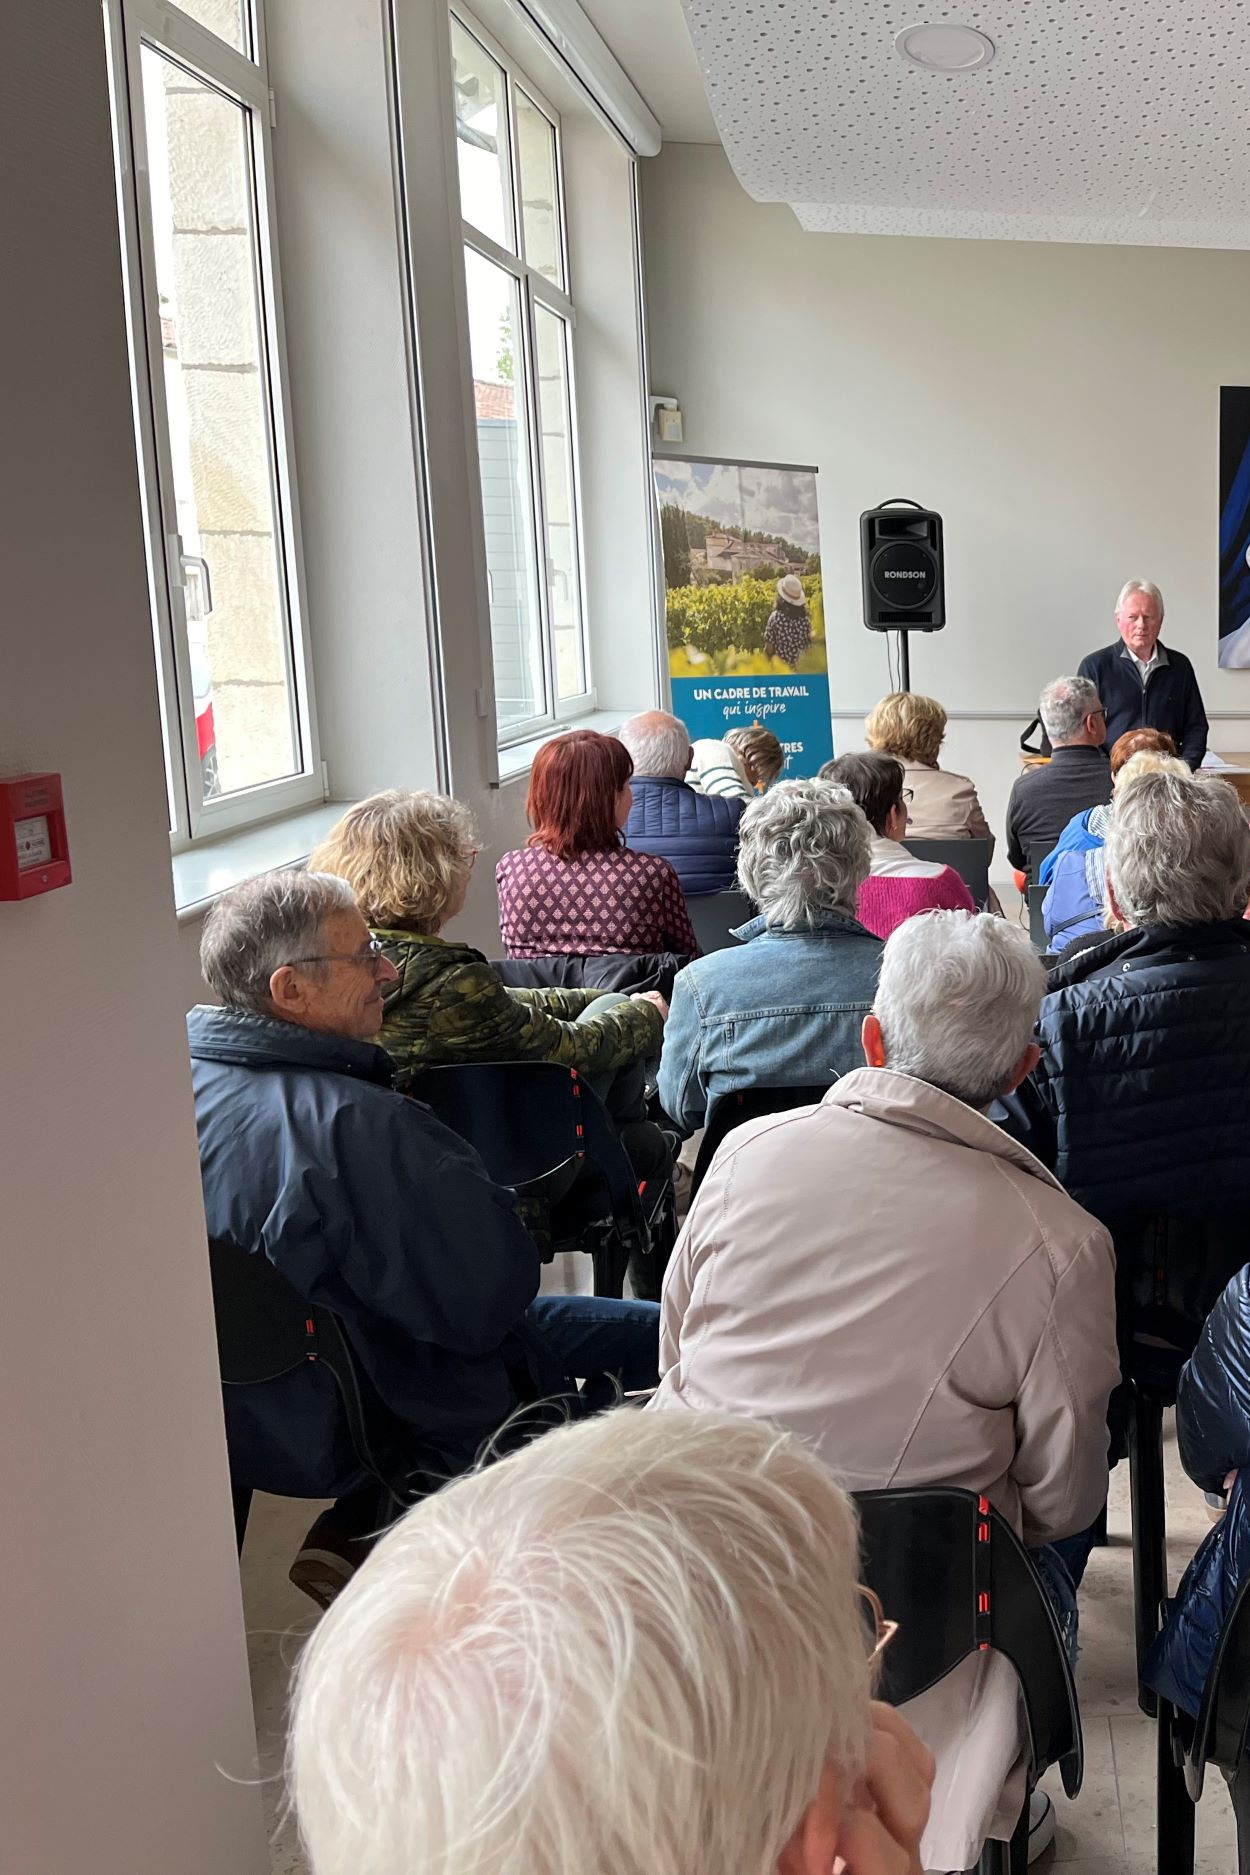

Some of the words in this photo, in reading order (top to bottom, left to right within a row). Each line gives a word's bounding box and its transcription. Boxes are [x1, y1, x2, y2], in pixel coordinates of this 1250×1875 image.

[884, 570, 926, 579] RONDSON
[694, 689, 712, 700] UN
[713, 688, 750, 699] CADRE
[752, 687, 767, 698] DE
[768, 686, 809, 697] TRAVAIL
[723, 700, 741, 719] qui
[745, 700, 787, 719] inspire
